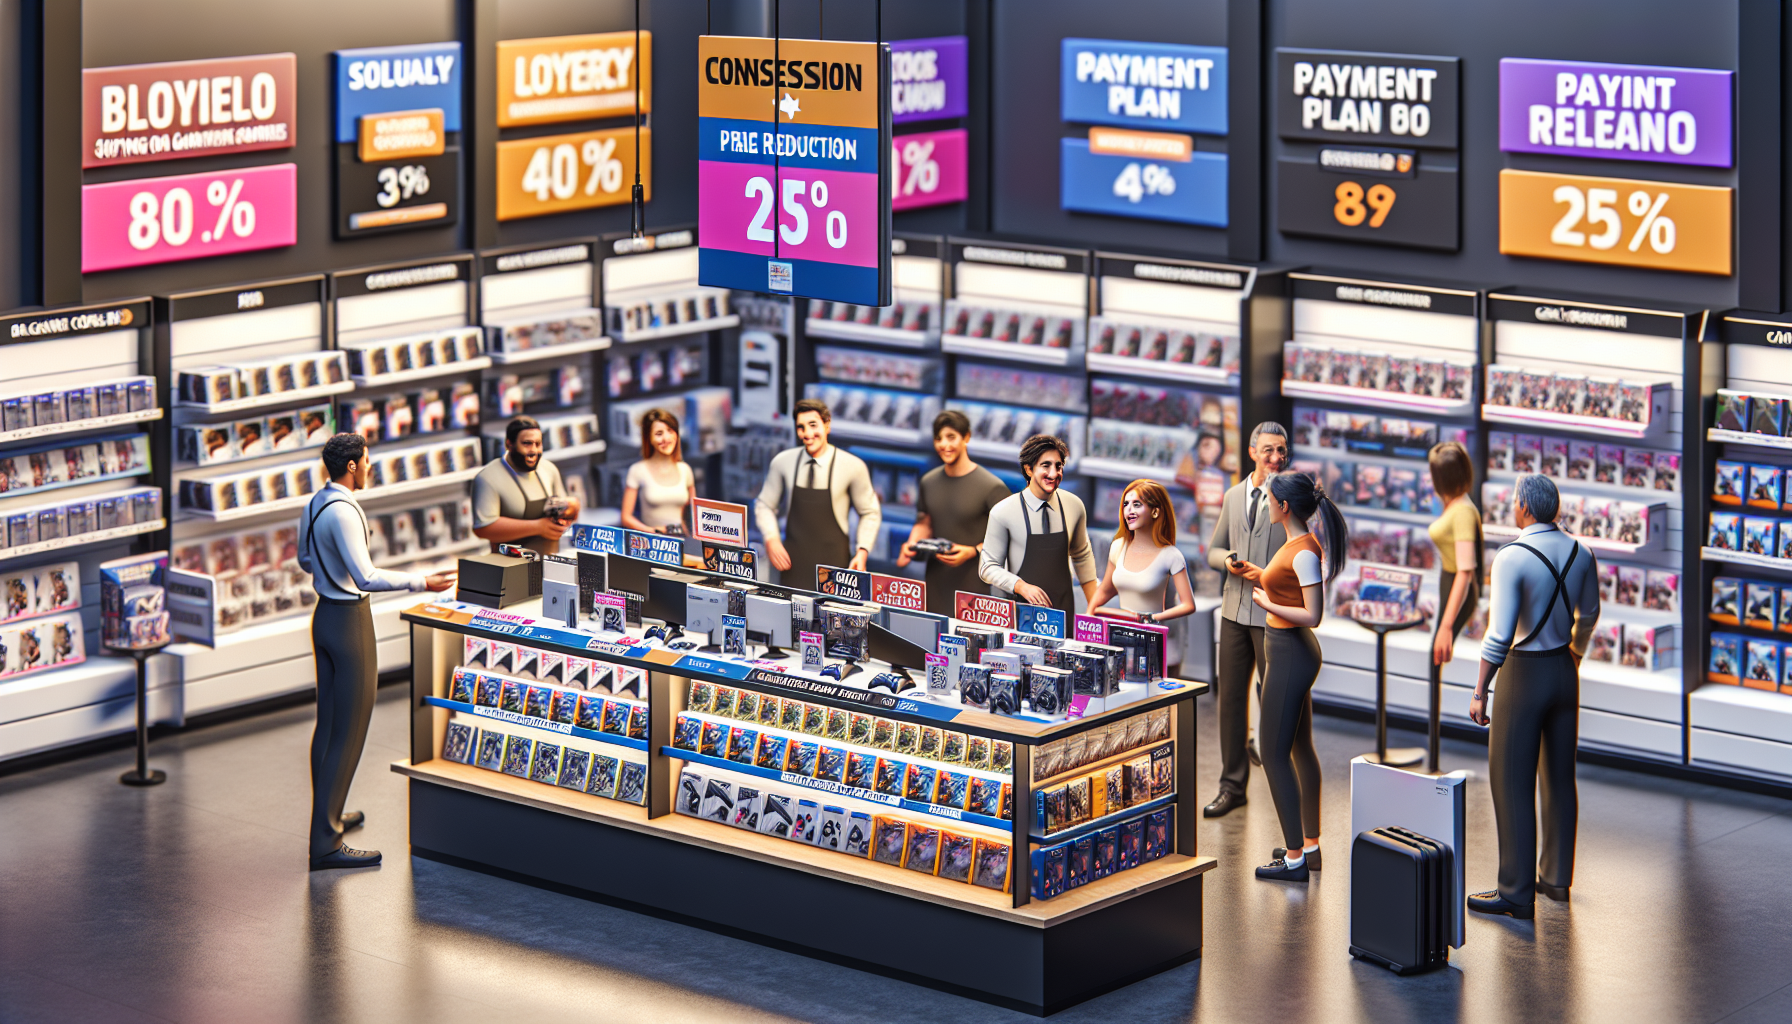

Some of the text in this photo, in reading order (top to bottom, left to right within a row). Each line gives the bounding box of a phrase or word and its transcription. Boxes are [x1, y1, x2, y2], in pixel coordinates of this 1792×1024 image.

[1076, 52, 1213, 91] PAYMENT
[1293, 63, 1437, 102] PAYMENT
[1556, 72, 1676, 110] PAYINT
[101, 72, 276, 133] BLOYIELO
[1108, 86, 1181, 120] PLAN
[1303, 97, 1381, 133] PLAN
[763, 132, 857, 160] REDUCTION
[376, 165, 430, 207] 3%
[1113, 163, 1176, 203] 4%
[1334, 181, 1397, 228] 89
[1550, 185, 1676, 254] 25%
